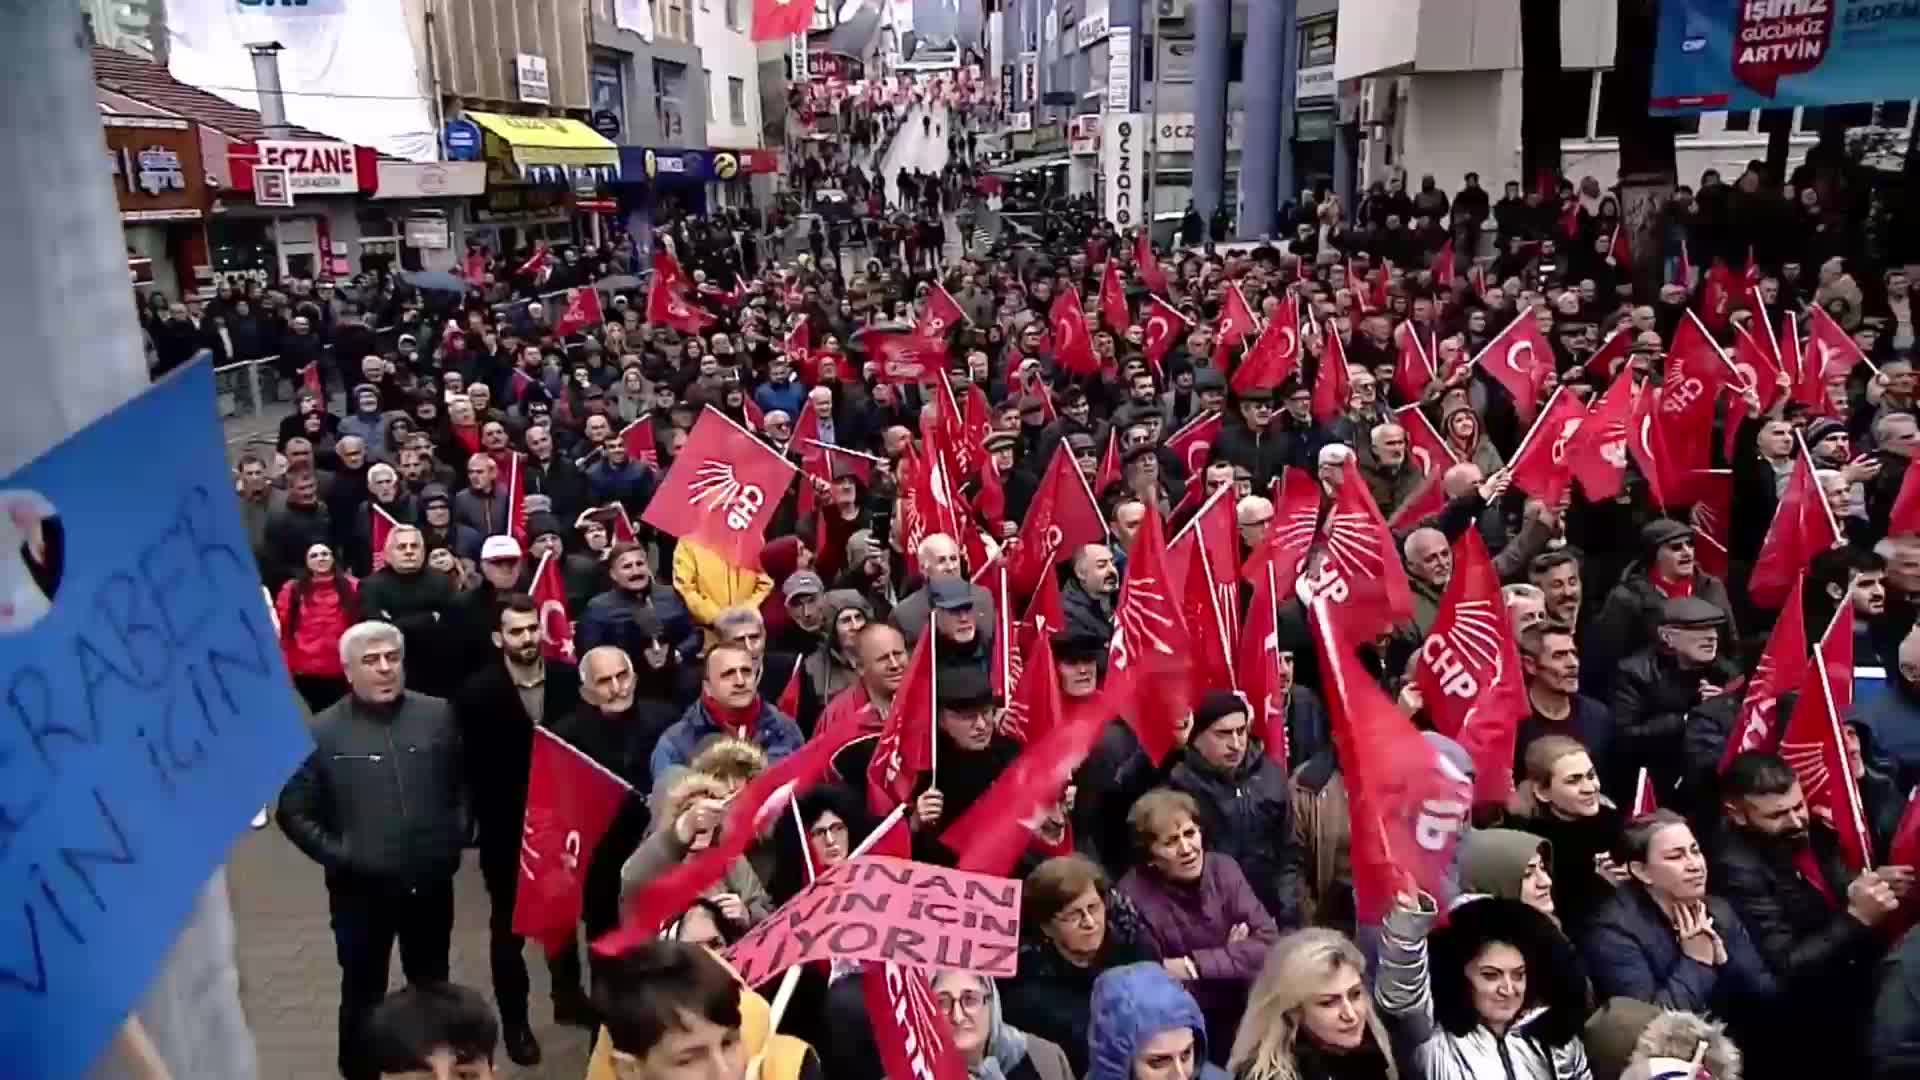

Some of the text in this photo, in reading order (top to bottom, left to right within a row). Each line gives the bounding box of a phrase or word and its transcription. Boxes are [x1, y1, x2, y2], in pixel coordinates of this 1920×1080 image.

[1741, 18, 1825, 42] GÜCÜMÜZ
[1739, 39, 1821, 64] ARTVİN
[265, 146, 353, 174] ECZANE
[727, 485, 764, 530] CHP
[1423, 633, 1478, 698] CHP
[906, 893, 1018, 937] İÇİN
